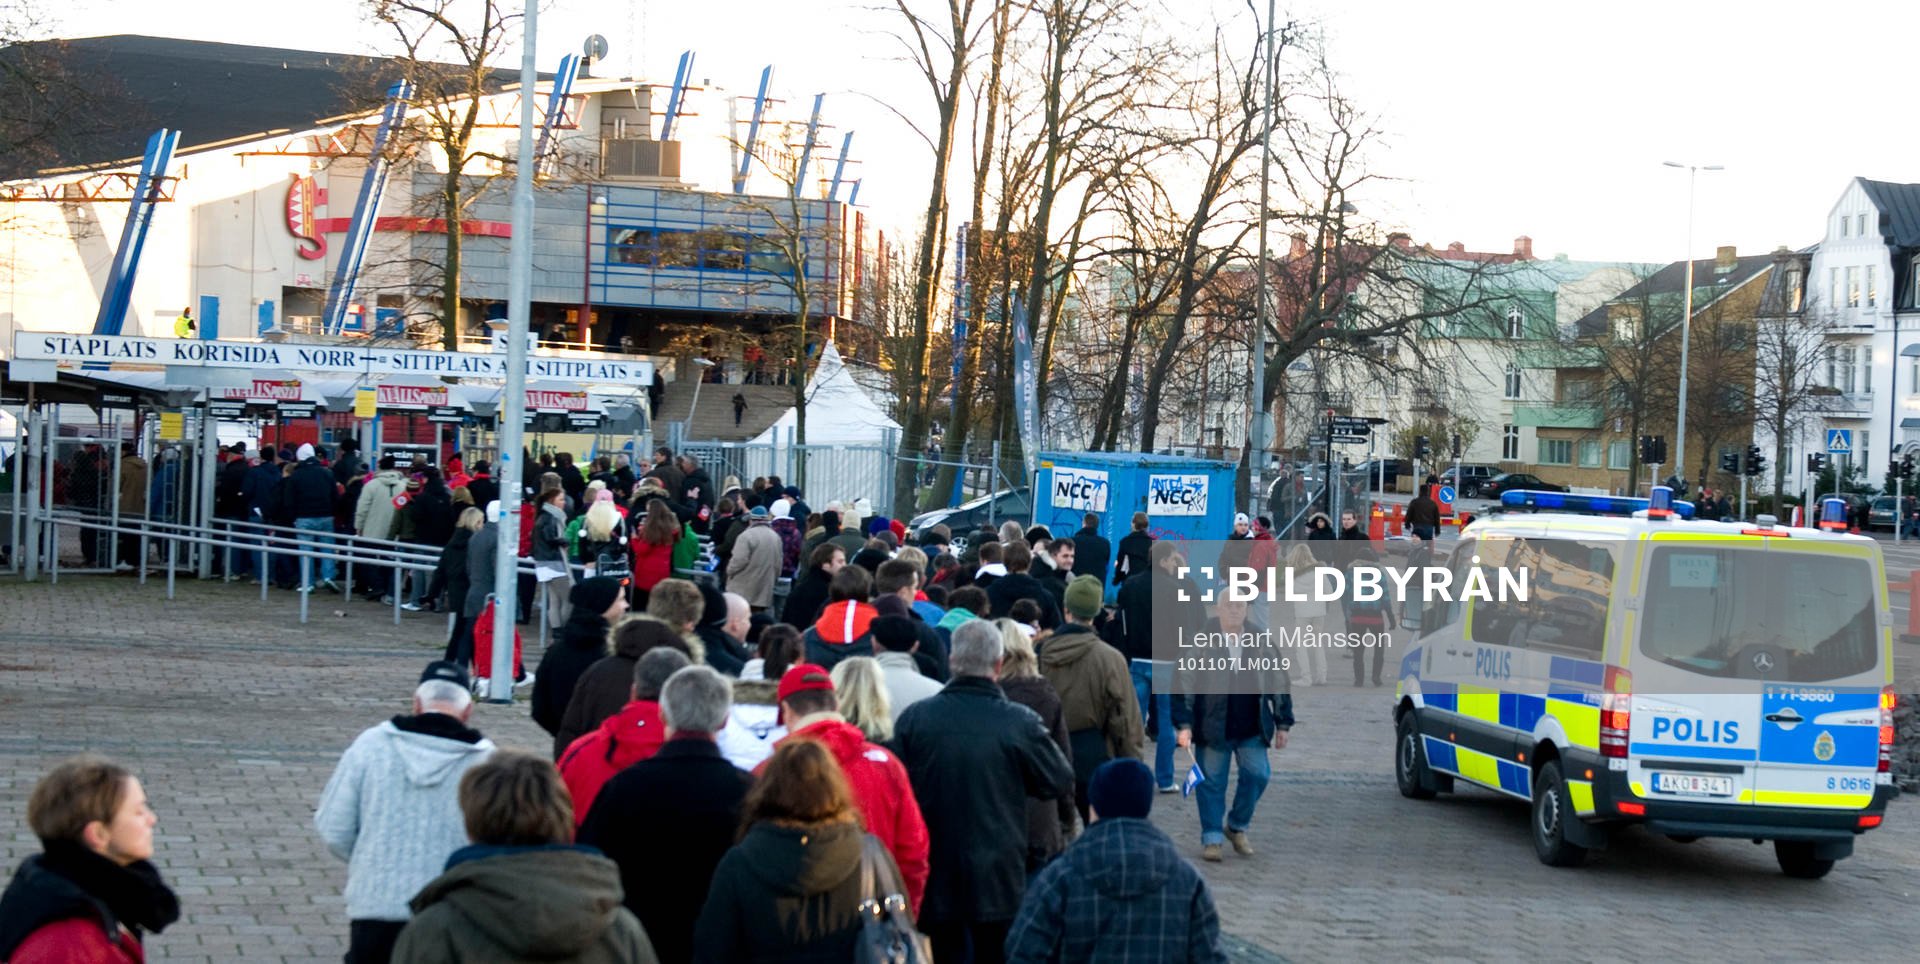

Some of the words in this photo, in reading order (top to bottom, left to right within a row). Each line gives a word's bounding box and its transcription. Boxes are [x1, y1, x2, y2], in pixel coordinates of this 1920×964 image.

[174, 343, 280, 364] KORTSIDA
[297, 349, 356, 367] NORR
[392, 353, 491, 373] SITTPLATS
[536, 361, 628, 379] SITTPLATS
[1056, 481, 1092, 500] NCC
[1154, 489, 1192, 504] NCC
[1476, 647, 1512, 679] POLIS
[1652, 716, 1739, 744] POLIS
[1701, 778, 1728, 793] 341
[1826, 776, 1836, 790] 8
[1840, 777, 1871, 791] 0616
